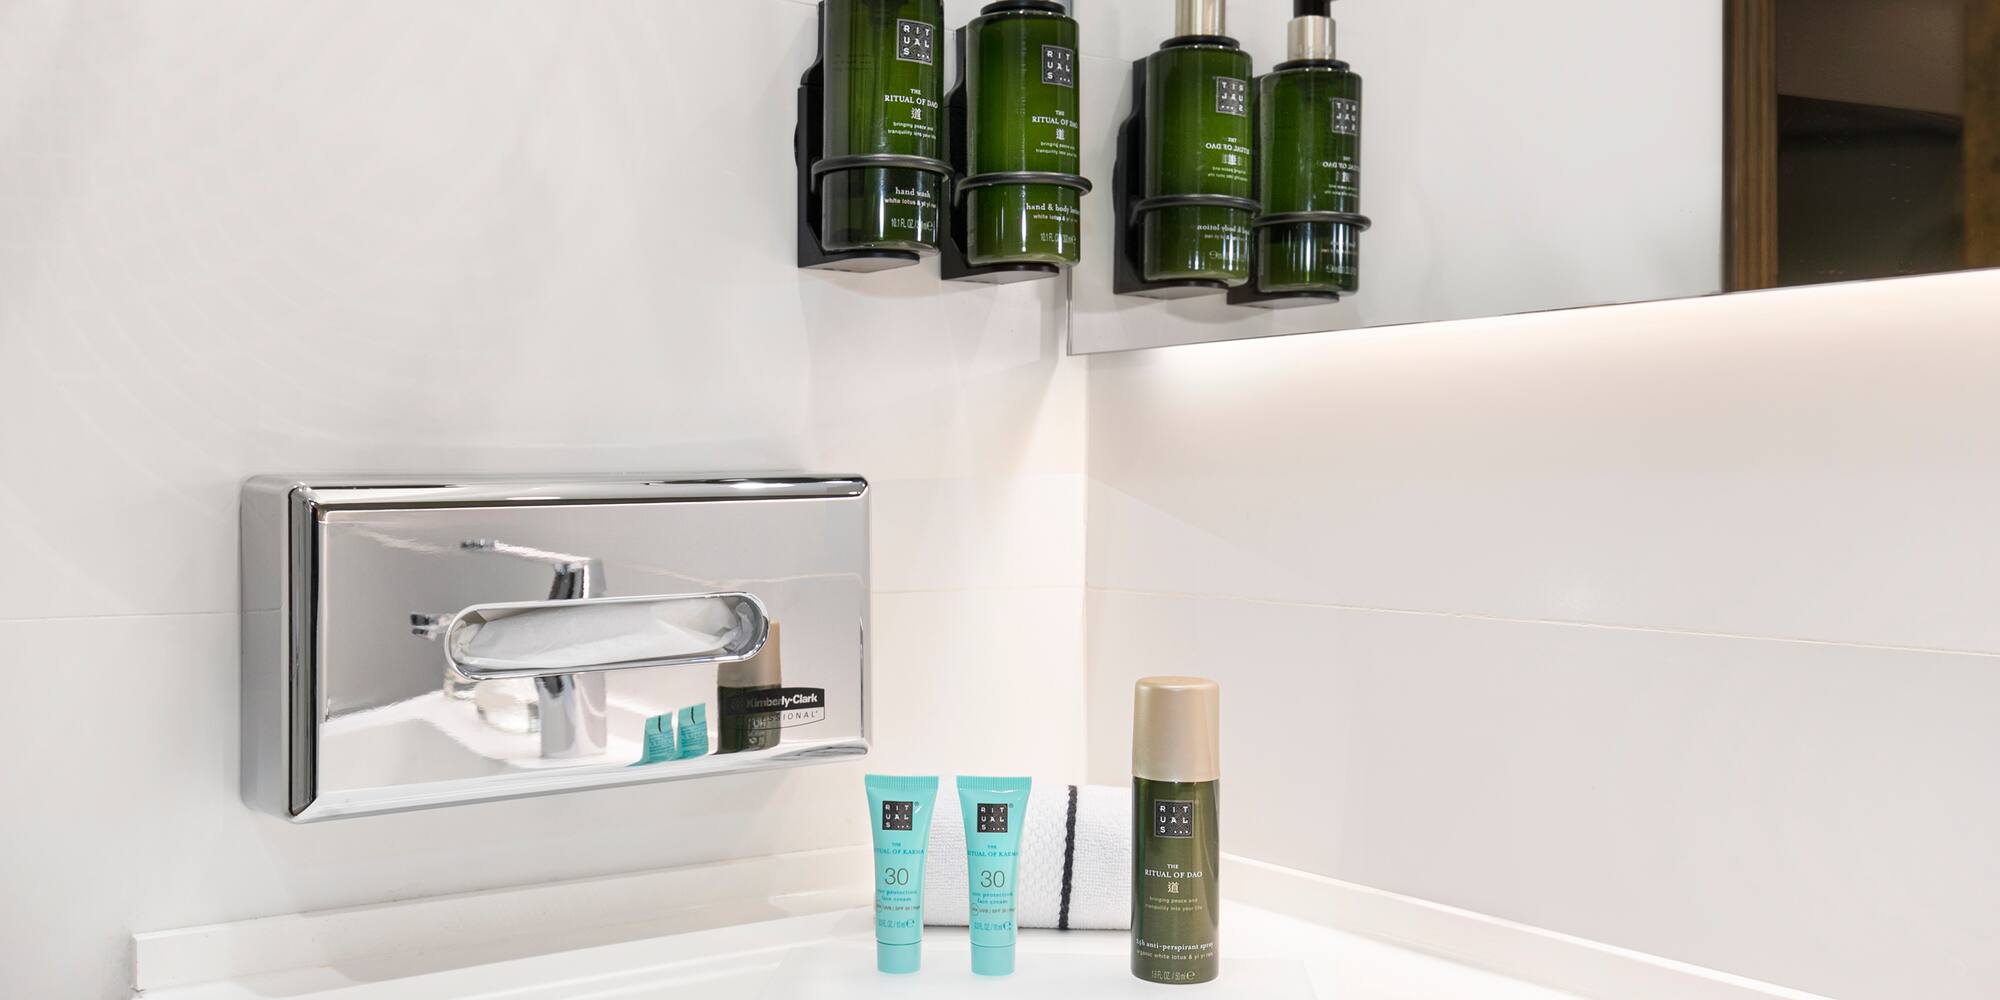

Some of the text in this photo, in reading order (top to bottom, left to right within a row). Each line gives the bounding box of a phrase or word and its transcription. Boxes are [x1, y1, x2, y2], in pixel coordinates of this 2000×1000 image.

[885, 95, 914, 104] RITUAL
[916, 98, 926, 106] OF
[1032, 116, 1059, 125] RITUAL
[896, 187, 915, 196] hand
[1026, 203, 1046, 211] hand
[1056, 204, 1069, 215] body
[885, 868, 909, 885] 30
[981, 870, 1005, 888] 30
[1145, 869, 1171, 878] RITUAL
[1168, 882, 1179, 893] 道
[1146, 942, 1199, 952] anti-perspirant
